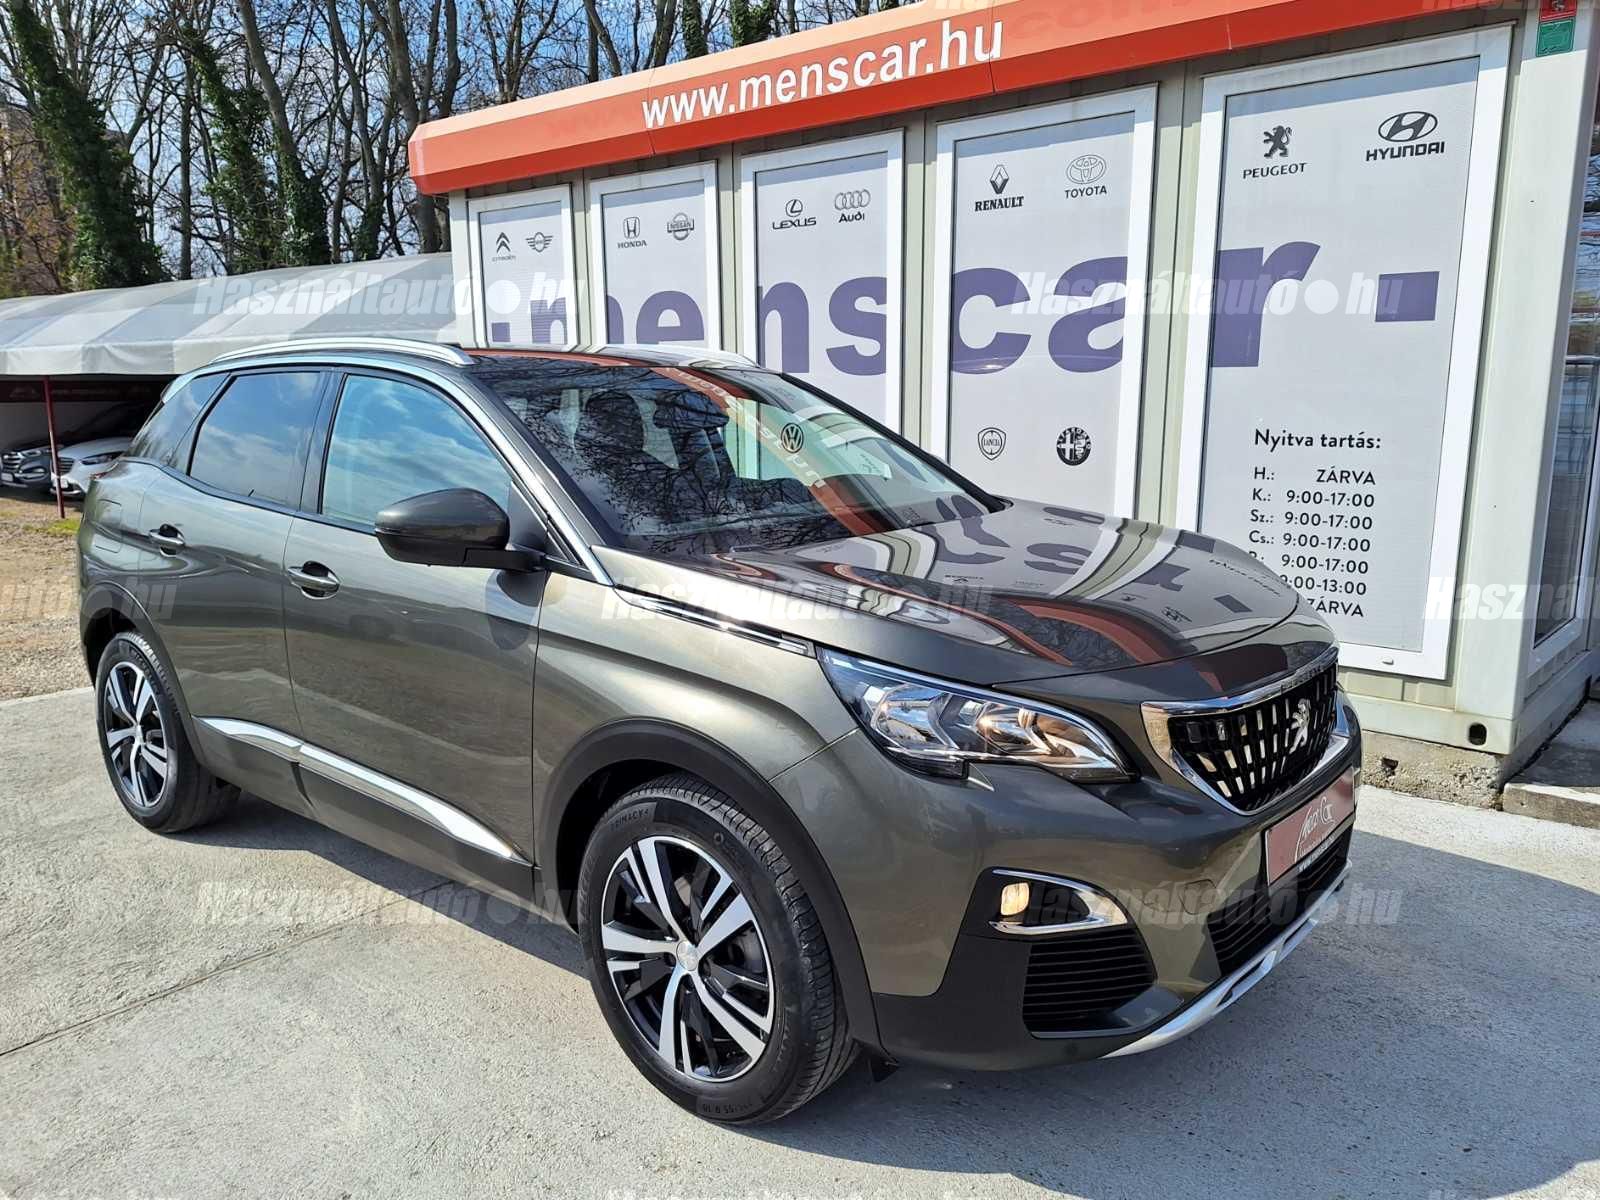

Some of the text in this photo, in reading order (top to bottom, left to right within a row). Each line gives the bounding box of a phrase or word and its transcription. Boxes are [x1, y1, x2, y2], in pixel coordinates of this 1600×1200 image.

[641, 20, 1004, 129] www.menscar.hu
[1365, 141, 1446, 162] HYUNDAI
[1242, 162, 1307, 180] PEUGEOT
[1064, 185, 1108, 199] TOYOTA
[974, 195, 1025, 212] RENAULT
[772, 216, 817, 230] LEXUS
[838, 212, 865, 224] Audi
[617, 239, 648, 249] HONDA
[1254, 428, 1381, 453] Nyitva tartás:
[1253, 465, 1376, 486] H.: ZÁRVA
[1252, 487, 1375, 508] K.: 9:00-17:00
[1284, 511, 1373, 530] 9:00-17:00
[1282, 532, 1371, 552] 9:00-17:00
[1281, 554, 1369, 574] 9:00-17:00
